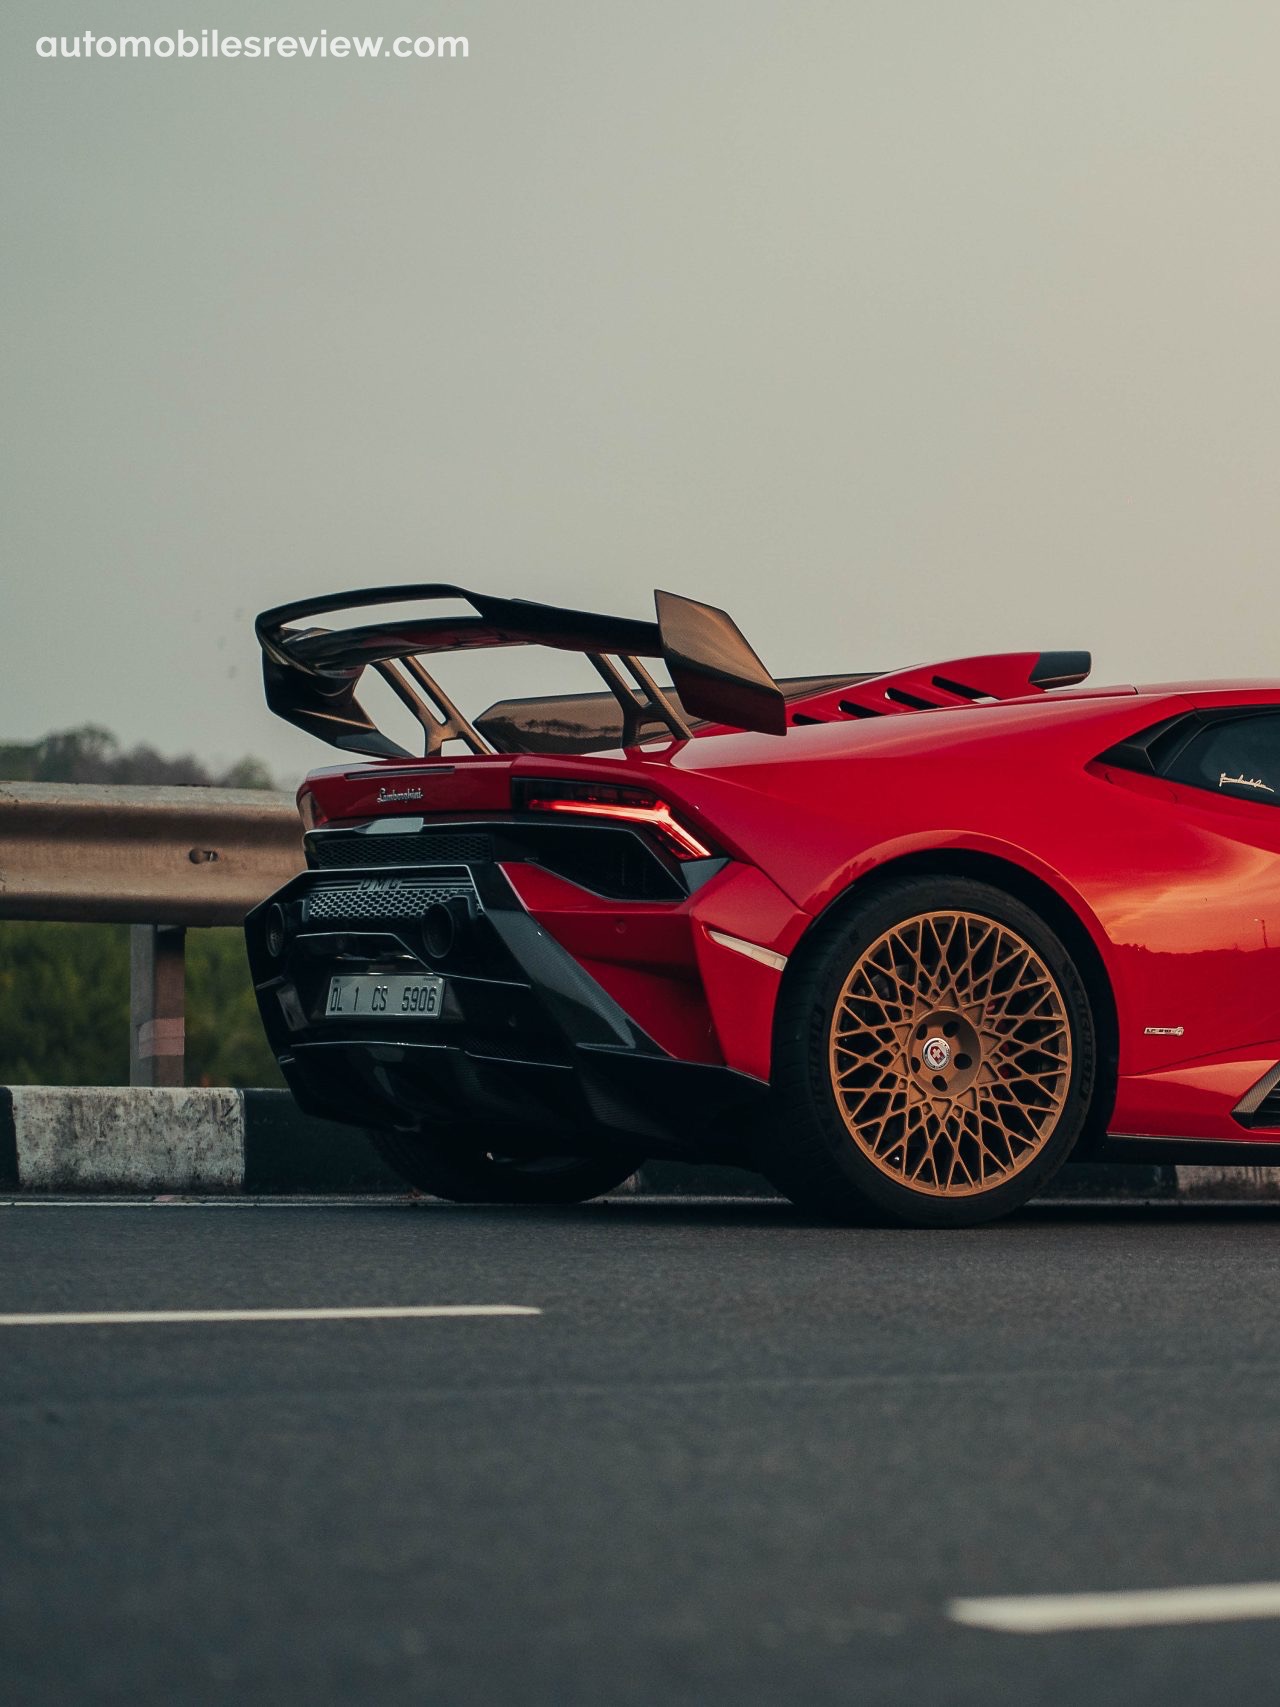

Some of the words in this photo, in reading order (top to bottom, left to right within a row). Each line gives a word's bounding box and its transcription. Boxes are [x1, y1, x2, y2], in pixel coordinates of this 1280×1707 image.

[330, 986, 342, 1012] DL
[353, 985, 360, 1012] 1
[371, 985, 389, 1012] CS
[401, 986, 437, 1012] 5906
